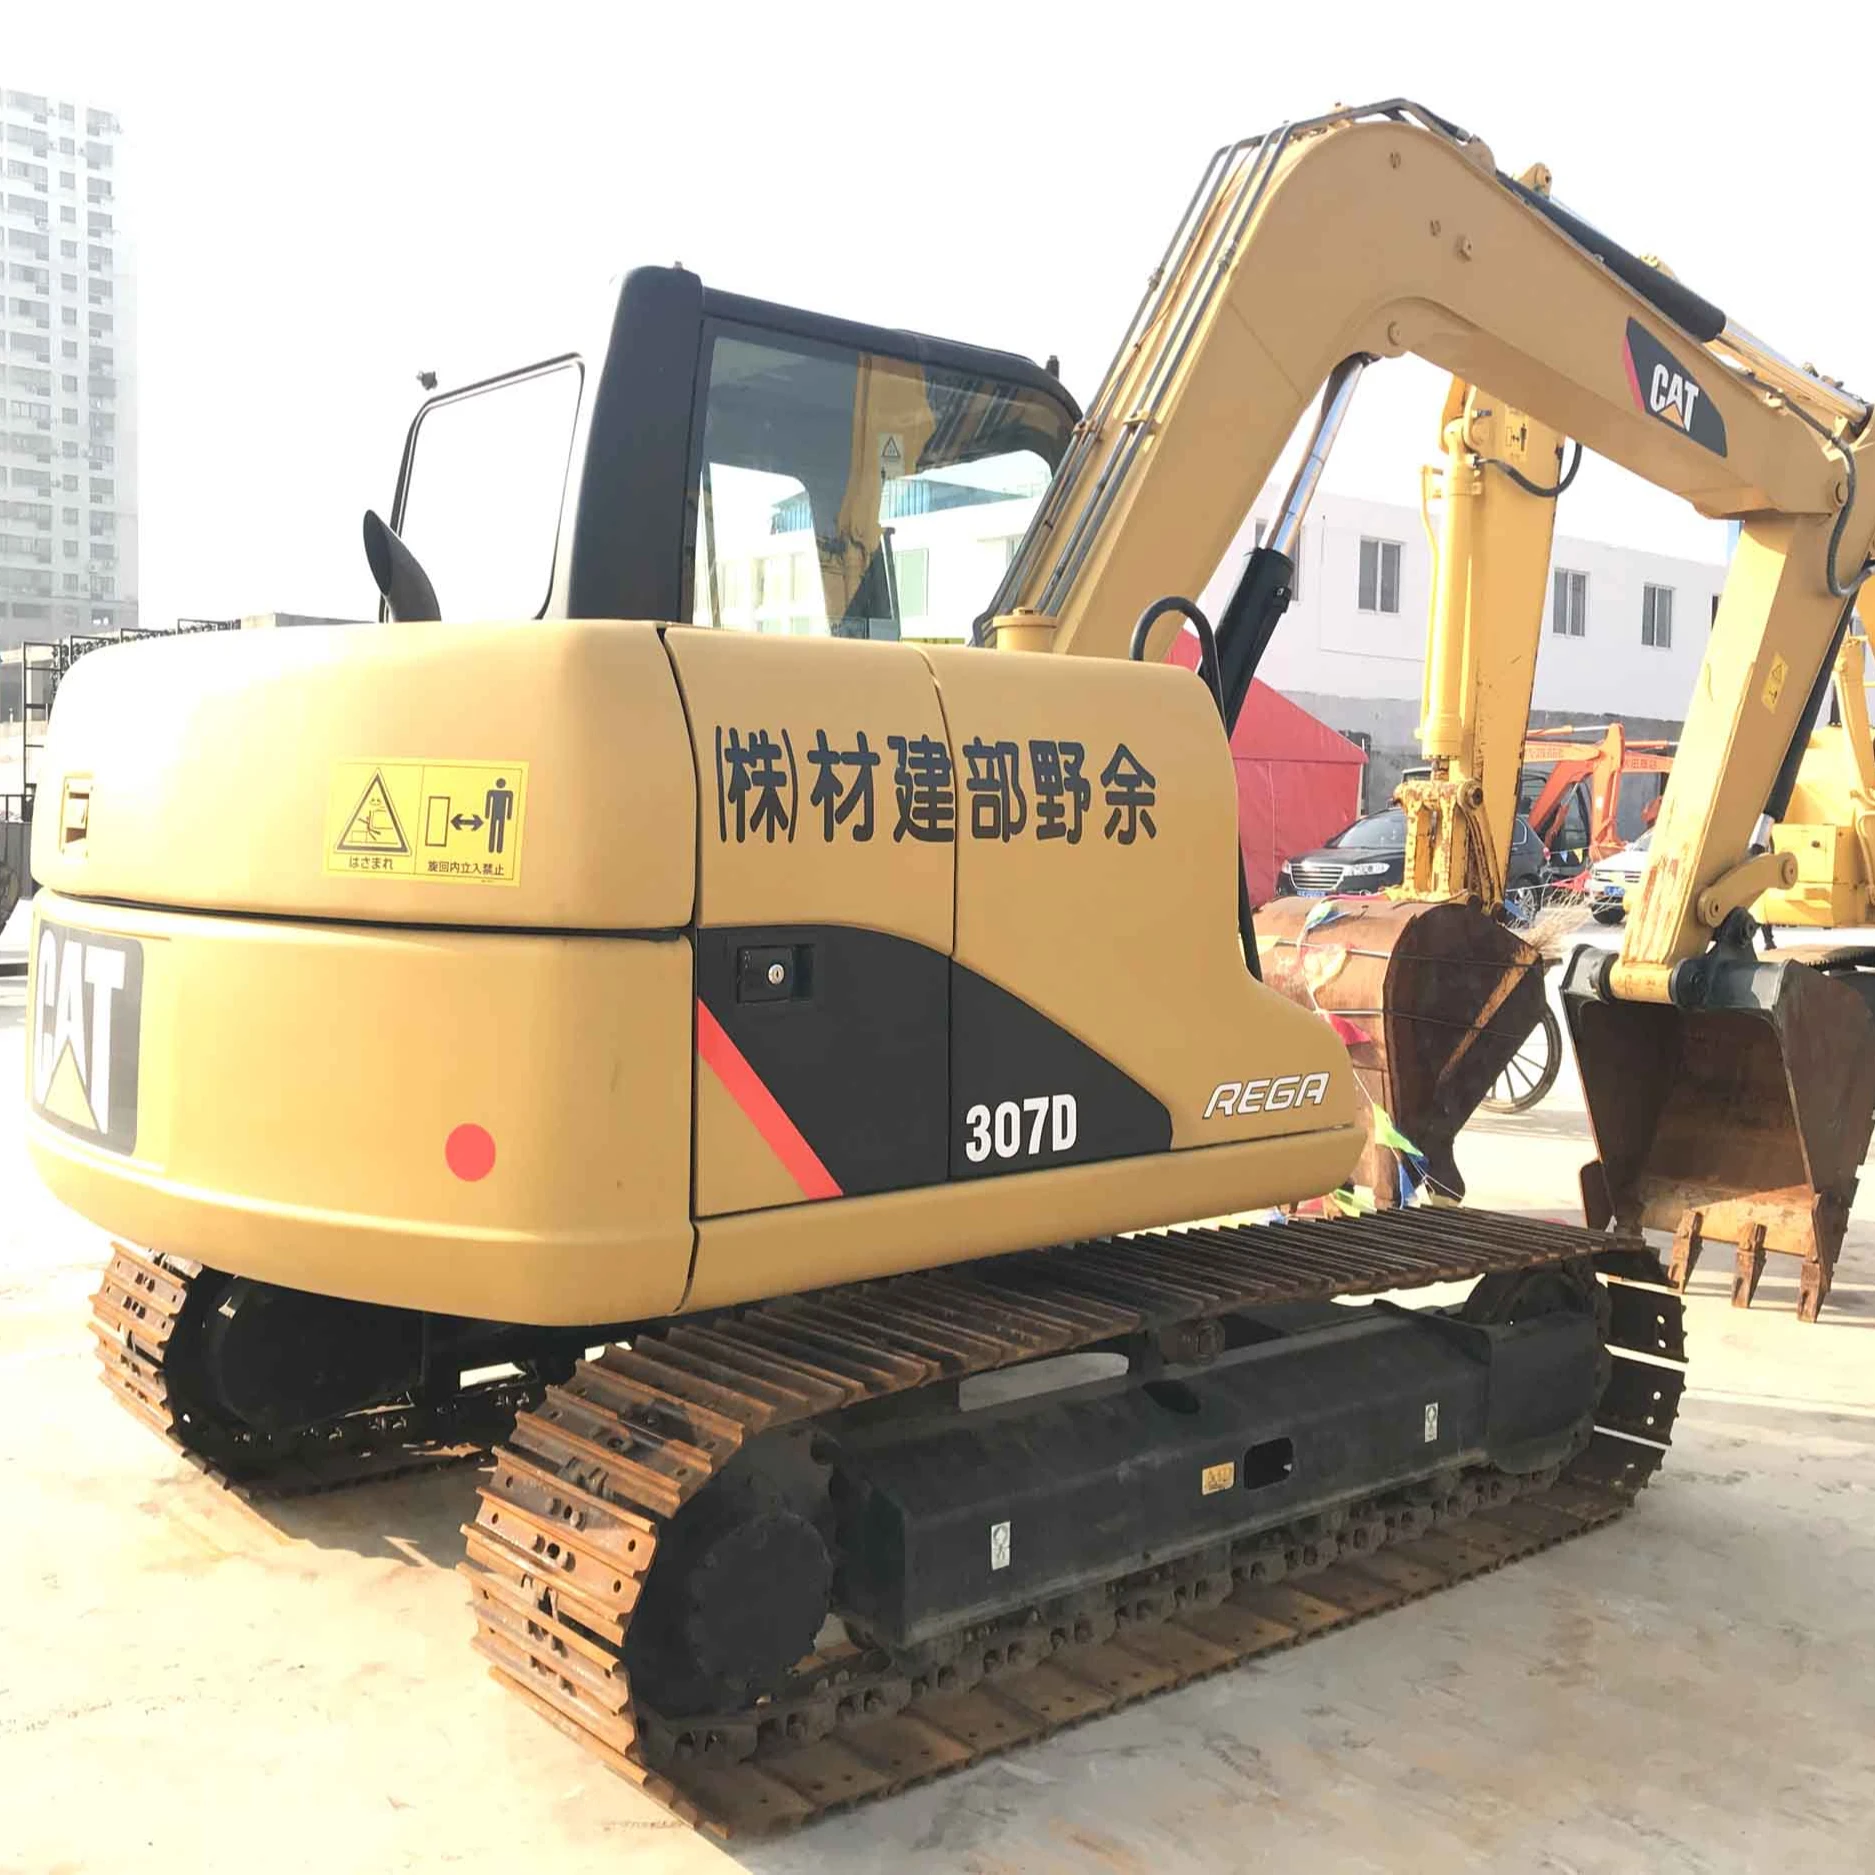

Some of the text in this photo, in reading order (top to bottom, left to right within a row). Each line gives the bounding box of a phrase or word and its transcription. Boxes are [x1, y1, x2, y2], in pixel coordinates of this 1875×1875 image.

[1649, 363, 1700, 432] CAT
[348, 855, 394, 871] はさまれ
[427, 861, 505, 876] 旋回内立入禁止
[34, 928, 126, 1135] CAT
[1202, 1071, 1331, 1120] REGA
[965, 1094, 1077, 1163] 307D
